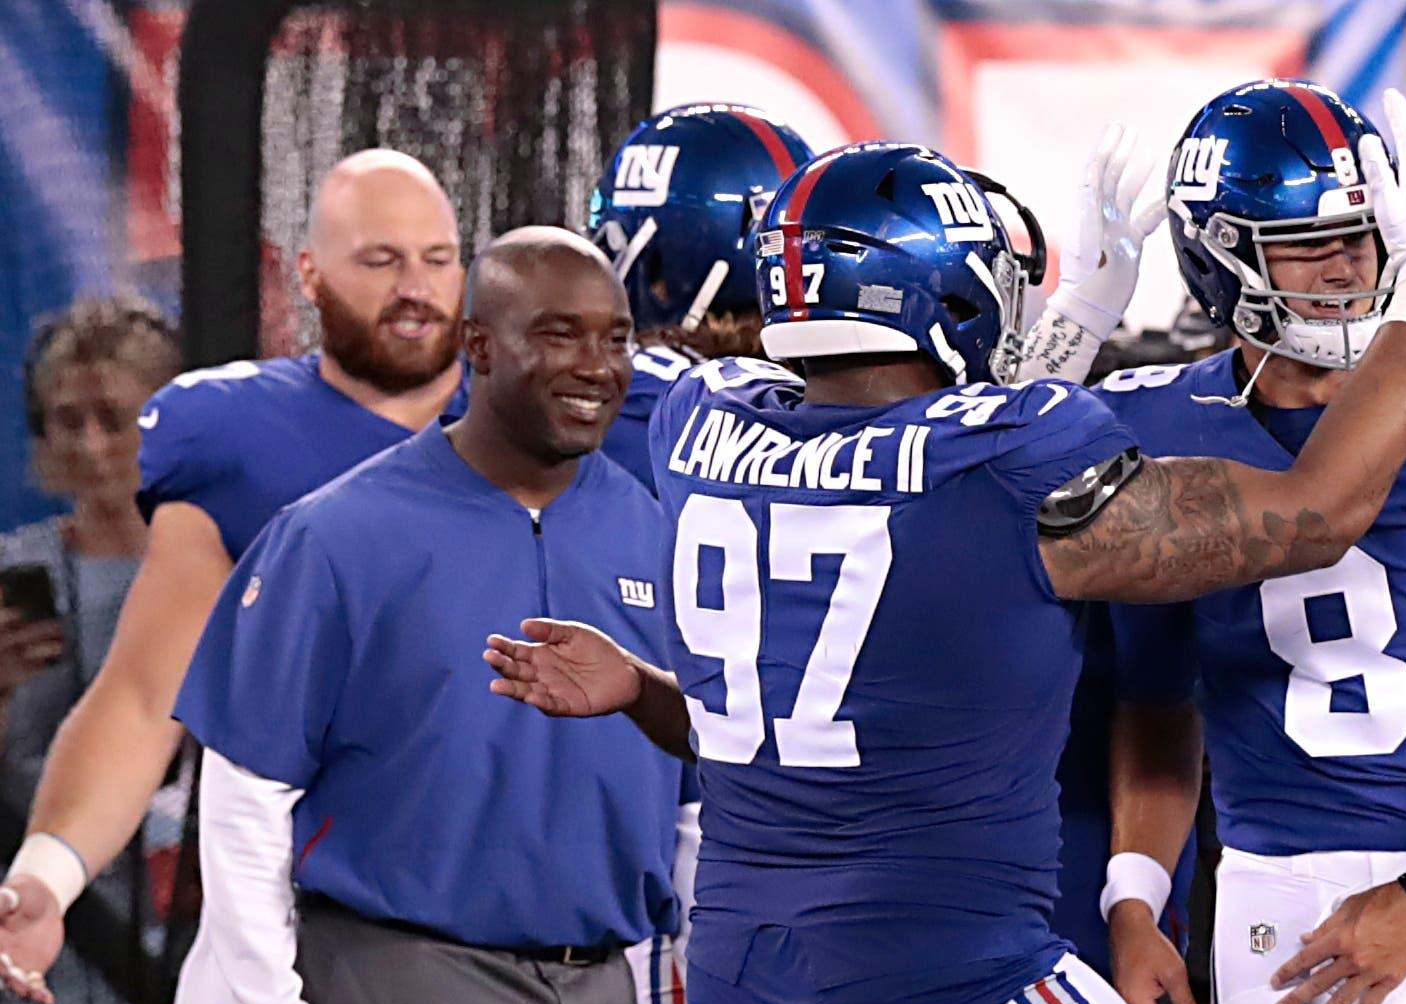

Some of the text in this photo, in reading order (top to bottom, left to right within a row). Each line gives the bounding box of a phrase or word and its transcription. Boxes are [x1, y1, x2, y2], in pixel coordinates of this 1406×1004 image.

[613, 145, 680, 206] ny
[1331, 147, 1359, 186] 8
[920, 181, 993, 242] ny
[769, 263, 825, 306] 97
[1102, 363, 1190, 393] 8
[667, 405, 931, 493] LAWRENCE II
[617, 577, 655, 608] ny
[672, 493, 893, 768] 97
